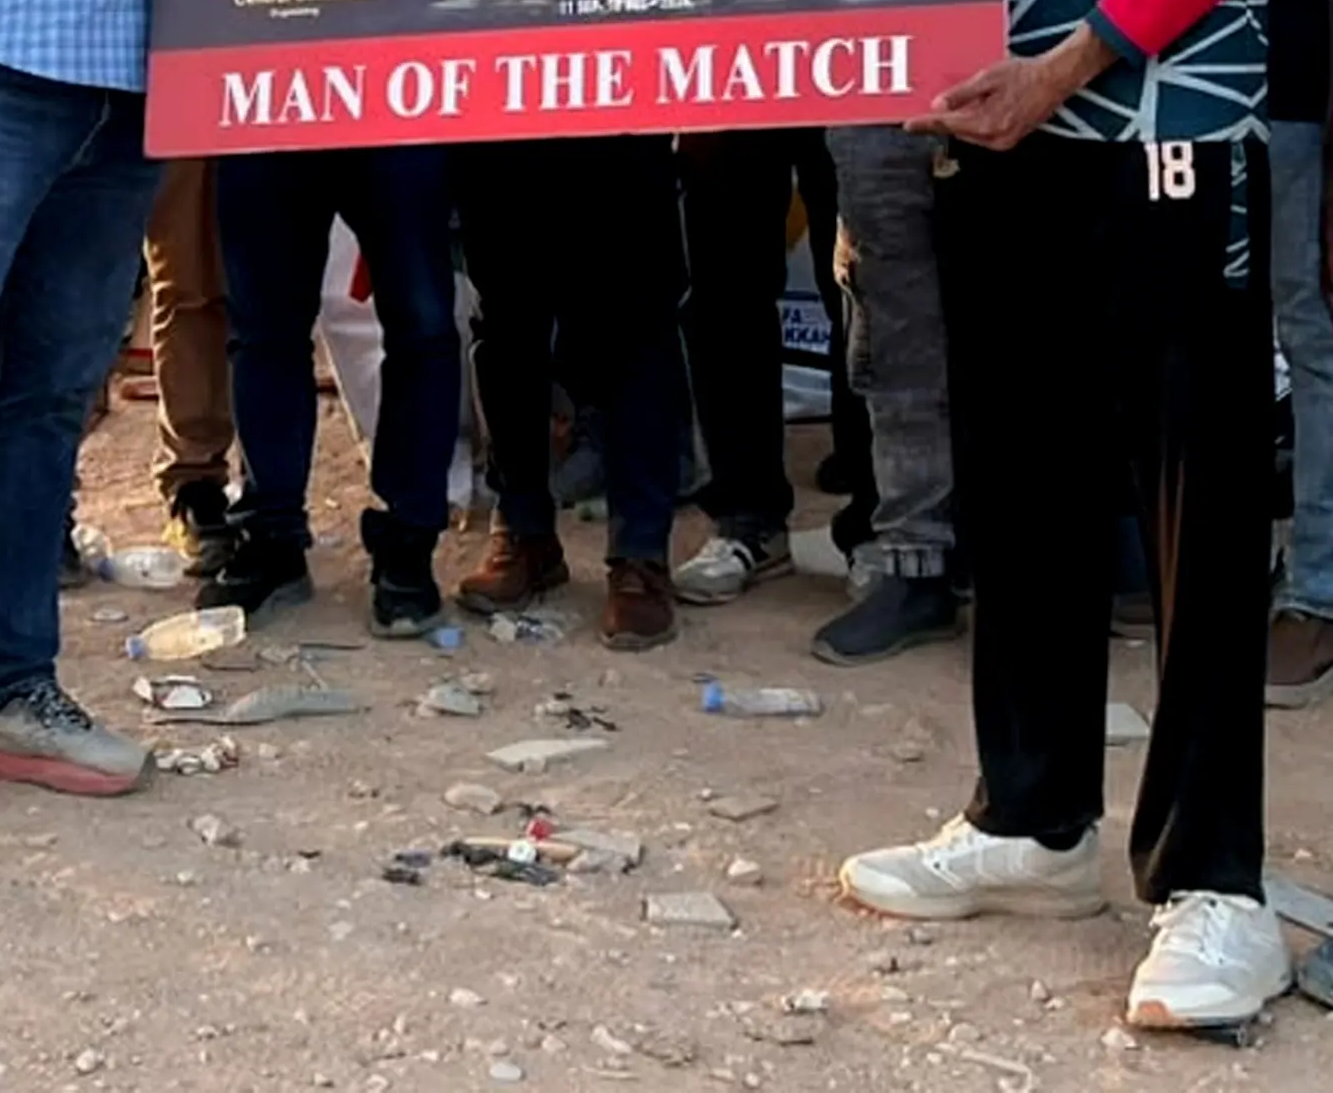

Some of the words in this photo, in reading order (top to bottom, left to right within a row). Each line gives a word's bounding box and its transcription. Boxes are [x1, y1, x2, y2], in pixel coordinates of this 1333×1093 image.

[219, 65, 366, 127] MAN
[387, 58, 477, 117] OF
[495, 50, 633, 114] THE
[655, 35, 915, 106] MATCH
[1144, 141, 1195, 201] 18
